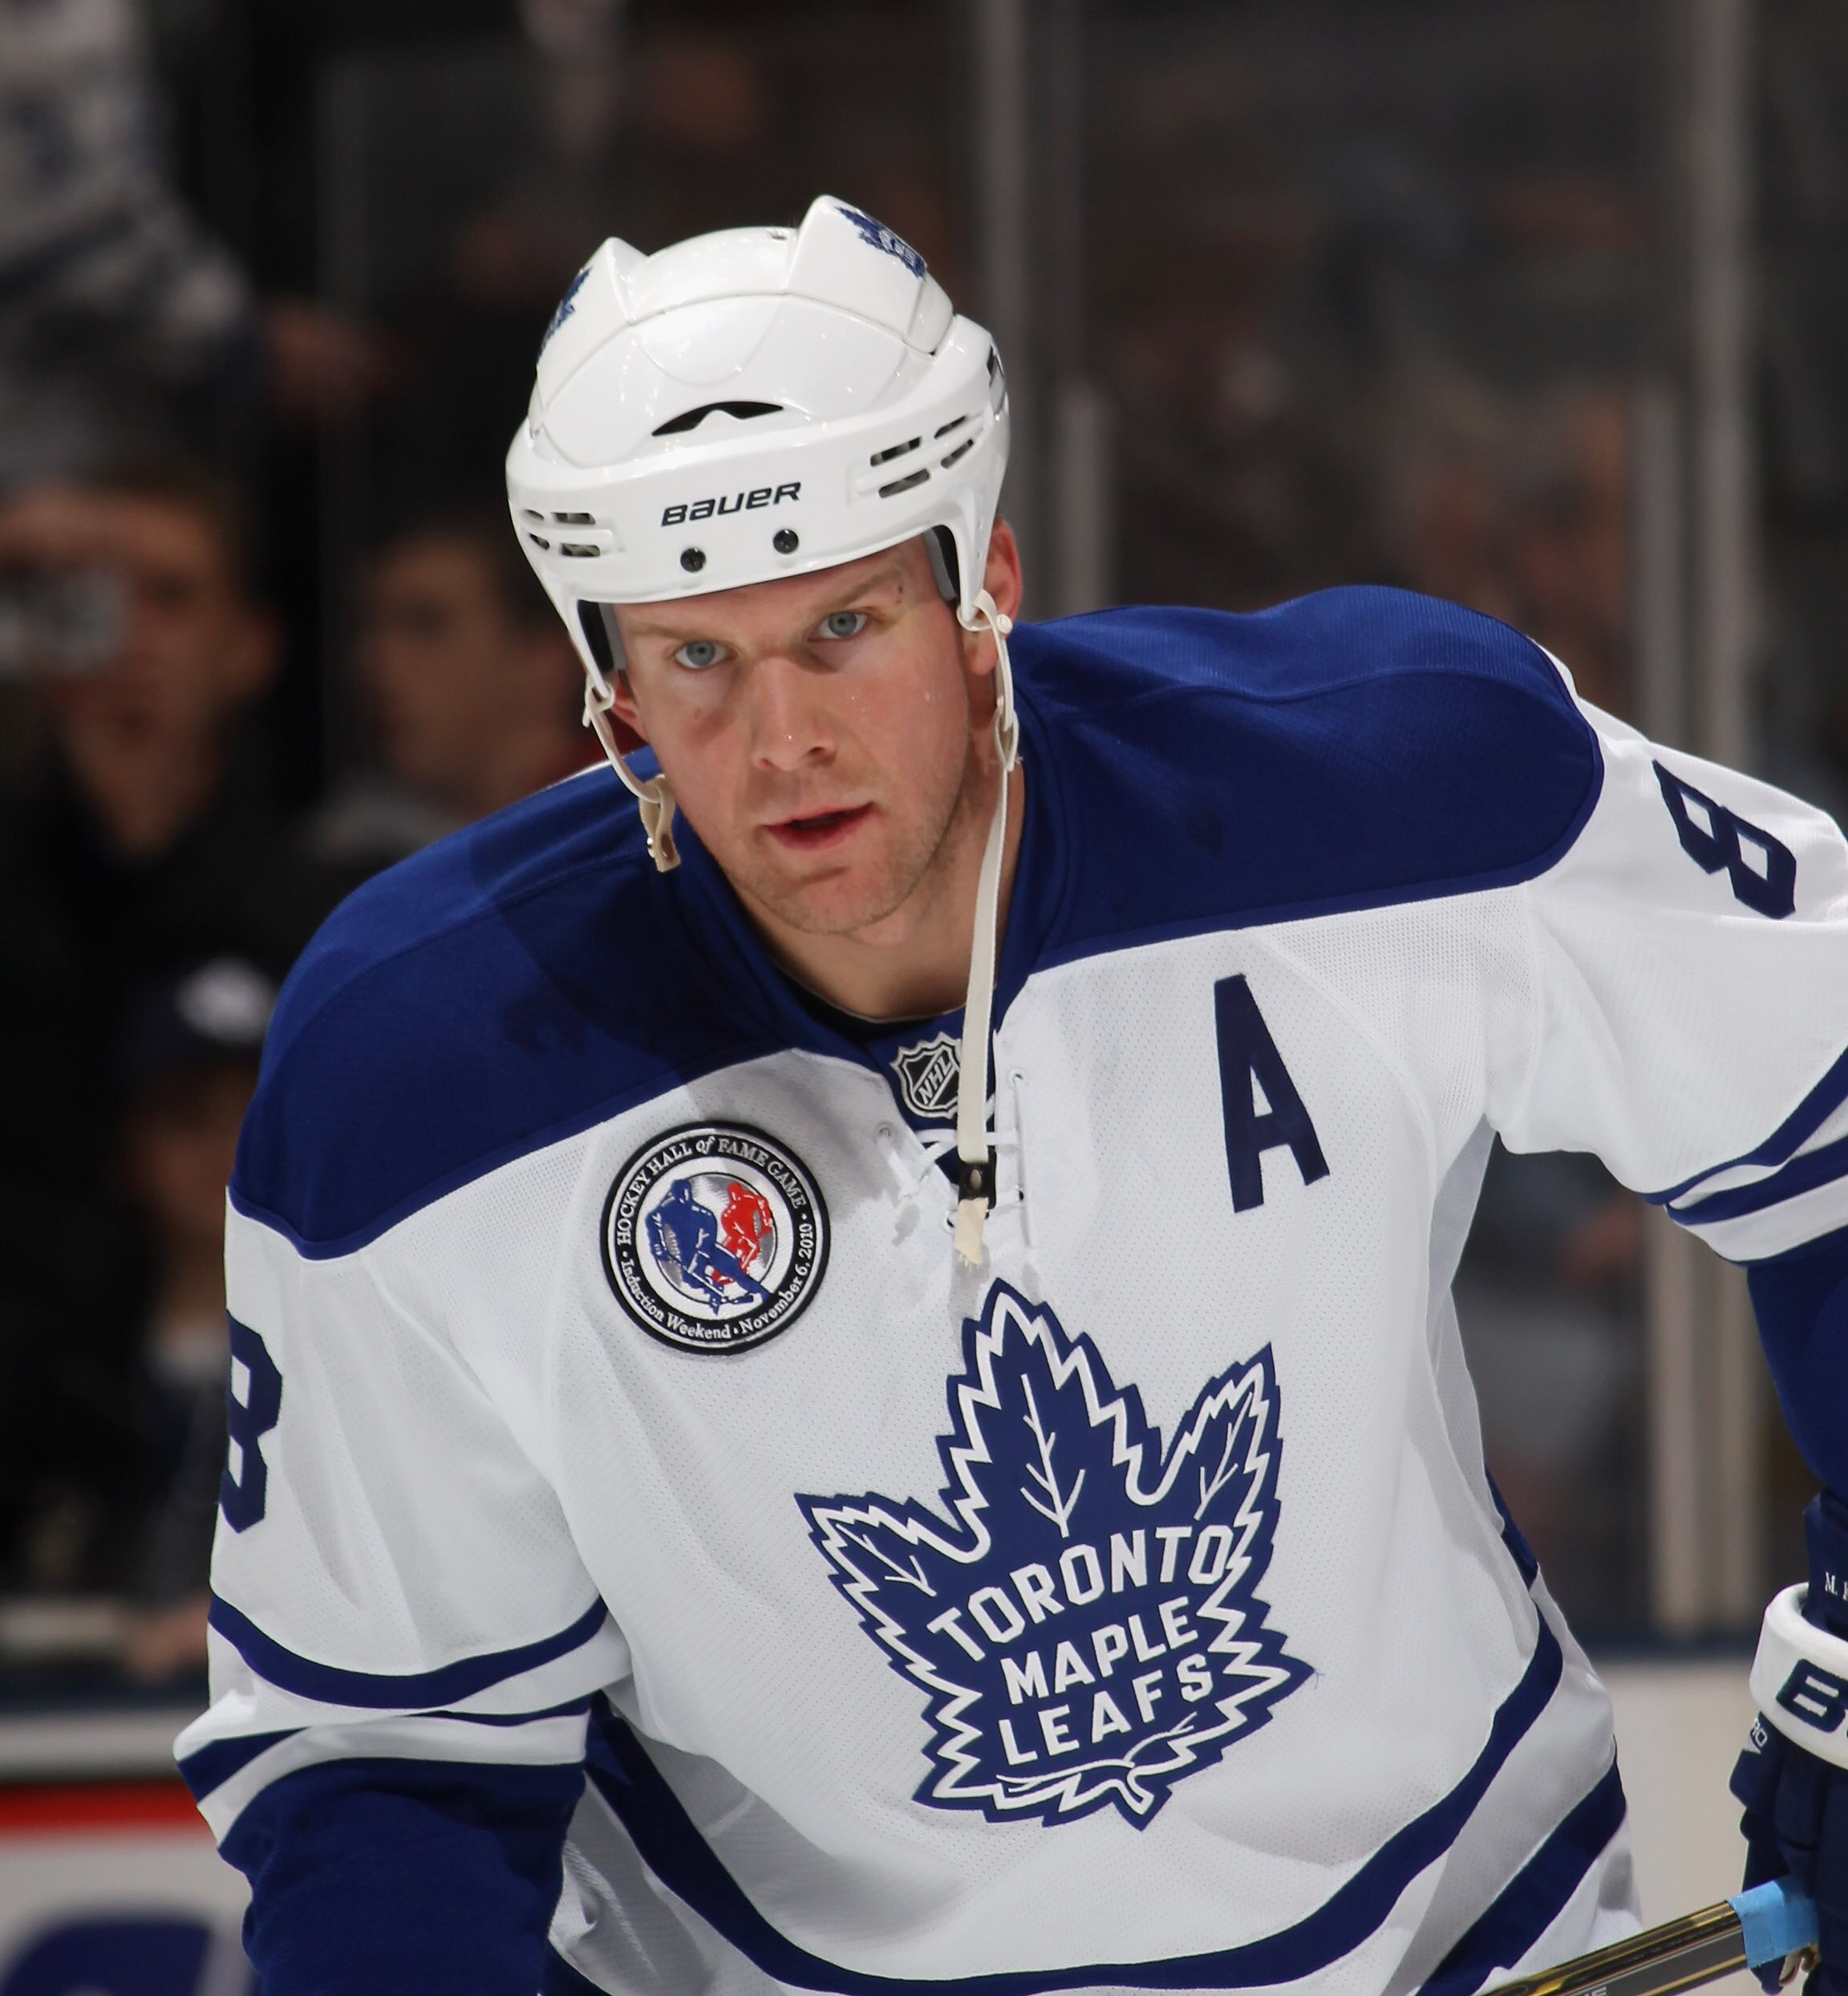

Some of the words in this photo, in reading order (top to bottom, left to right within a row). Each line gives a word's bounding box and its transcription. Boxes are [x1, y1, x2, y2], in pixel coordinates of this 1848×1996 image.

[1651, 759, 1797, 920] 8
[918, 1056, 953, 1106] NHL
[1214, 972, 1331, 1214] A
[617, 1169, 651, 1246] HOCKEY
[646, 1142, 693, 1176] HALL
[695, 1135, 716, 1154] of
[717, 1138, 769, 1167] FAME
[767, 1161, 807, 1209] GAME
[621, 1259, 664, 1315] Induction
[667, 1312, 732, 1340] Weekend
[737, 1276, 804, 1334] November
[798, 1223, 814, 1260] 2010
[926, 1524, 1234, 1662] TORONTO
[999, 1596, 1198, 1705] MAPLE
[998, 1653, 1214, 1765] LEAFS
